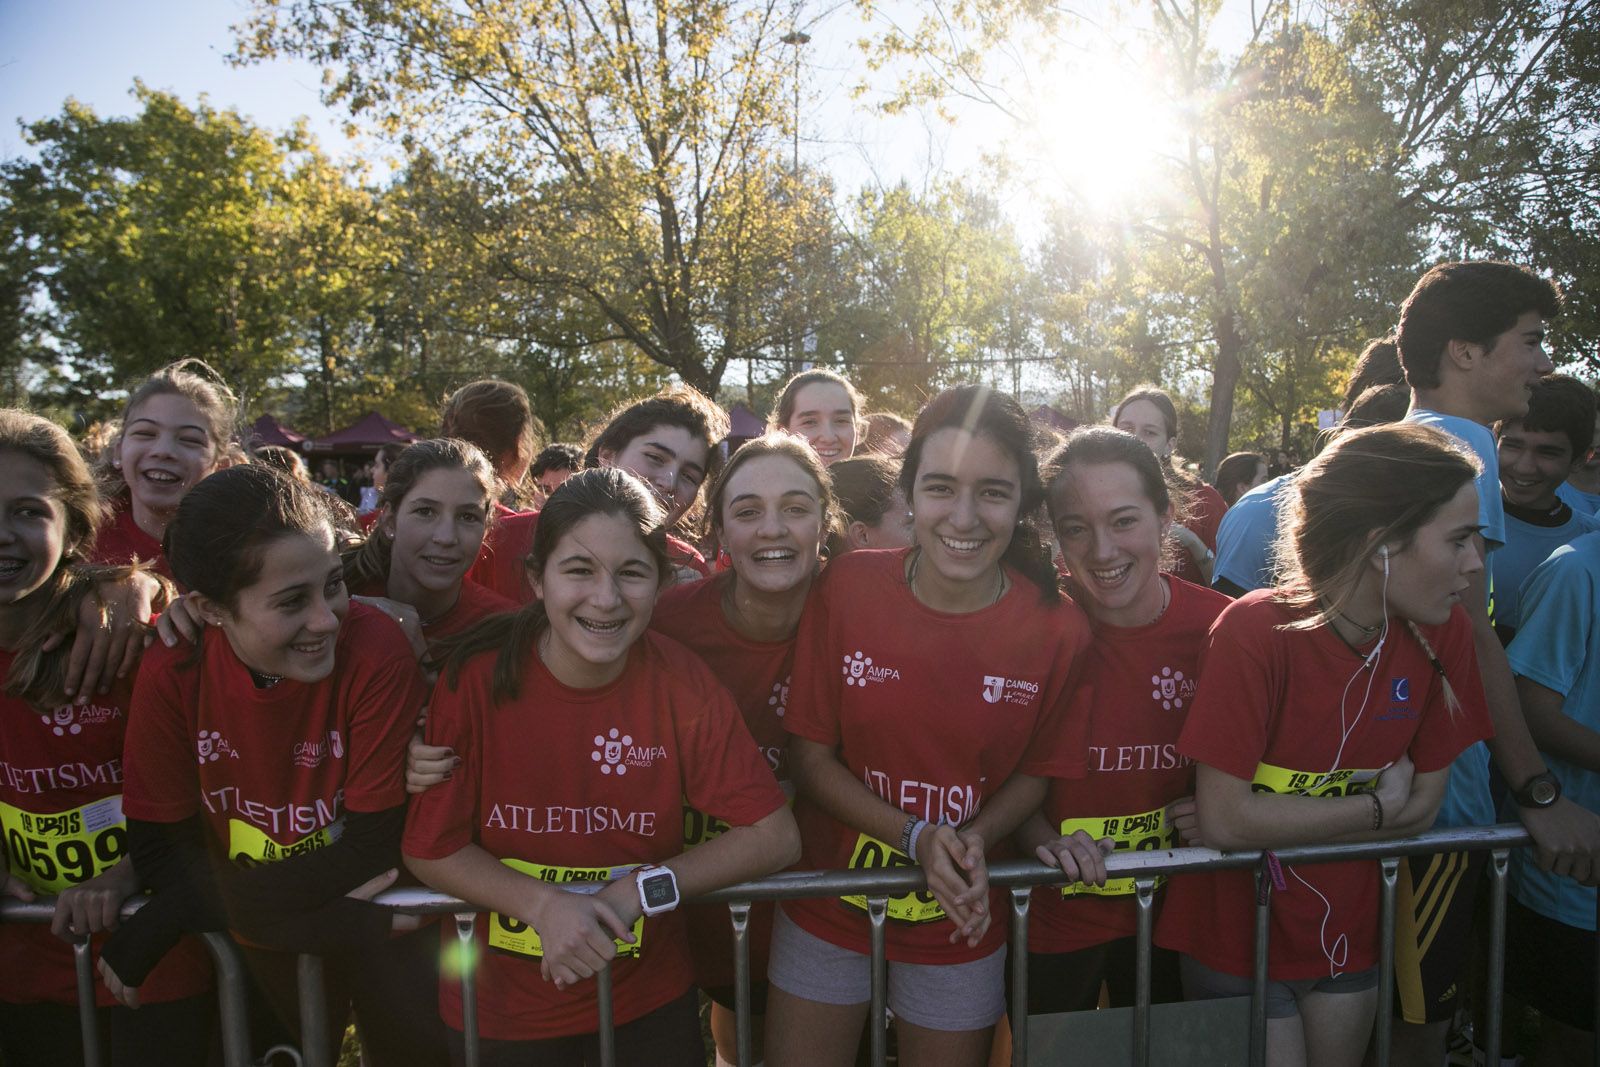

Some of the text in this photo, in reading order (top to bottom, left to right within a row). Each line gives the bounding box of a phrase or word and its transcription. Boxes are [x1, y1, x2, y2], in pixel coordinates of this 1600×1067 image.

[866, 665, 900, 681] AMPA
[1005, 679, 1039, 693] CANIGÓ
[1180, 679, 1199, 692] AM
[79, 704, 122, 719] AMPA
[626, 745, 668, 761] AMPA
[1287, 773, 1309, 788] 19
[20, 812, 34, 833] 19
[36, 811, 80, 836] CROS
[485, 803, 657, 837] ATLETISME
[1103, 811, 1161, 836] 19 CROS
[9, 827, 128, 884] 0599
[262, 839, 276, 860] 19
